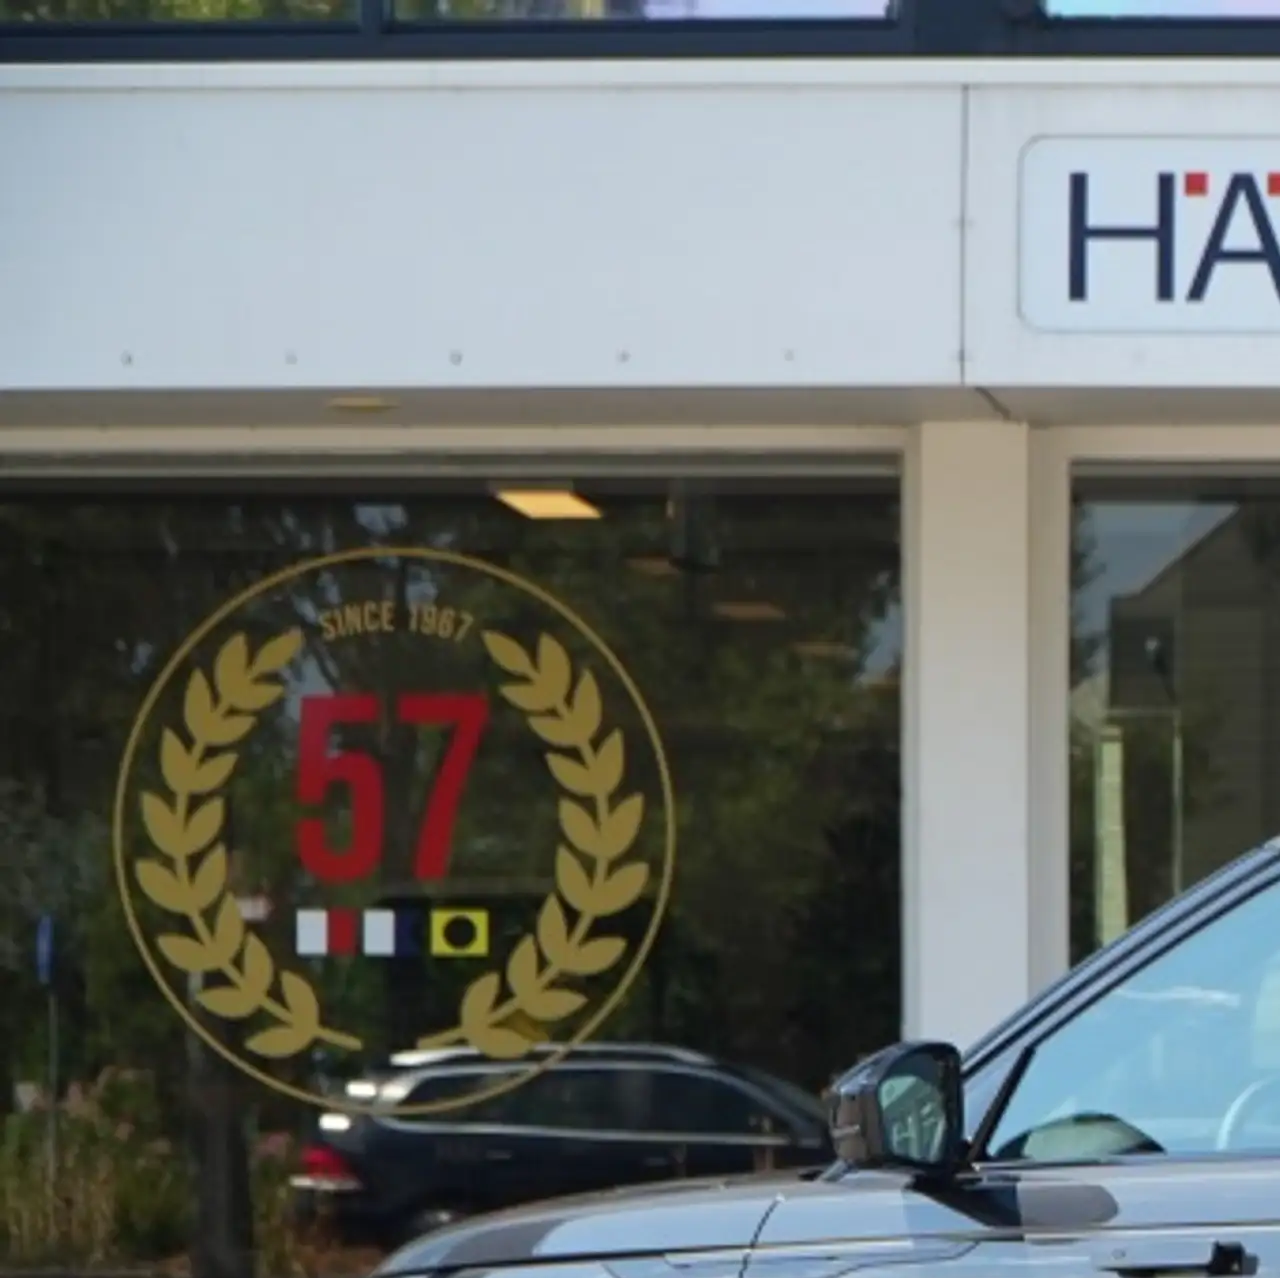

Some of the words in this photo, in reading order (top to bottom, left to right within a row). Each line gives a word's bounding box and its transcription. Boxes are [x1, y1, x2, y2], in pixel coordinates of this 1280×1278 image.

[318, 601, 396, 641] SINCE
[408, 603, 474, 642] 1967
[294, 693, 489, 884] 57
